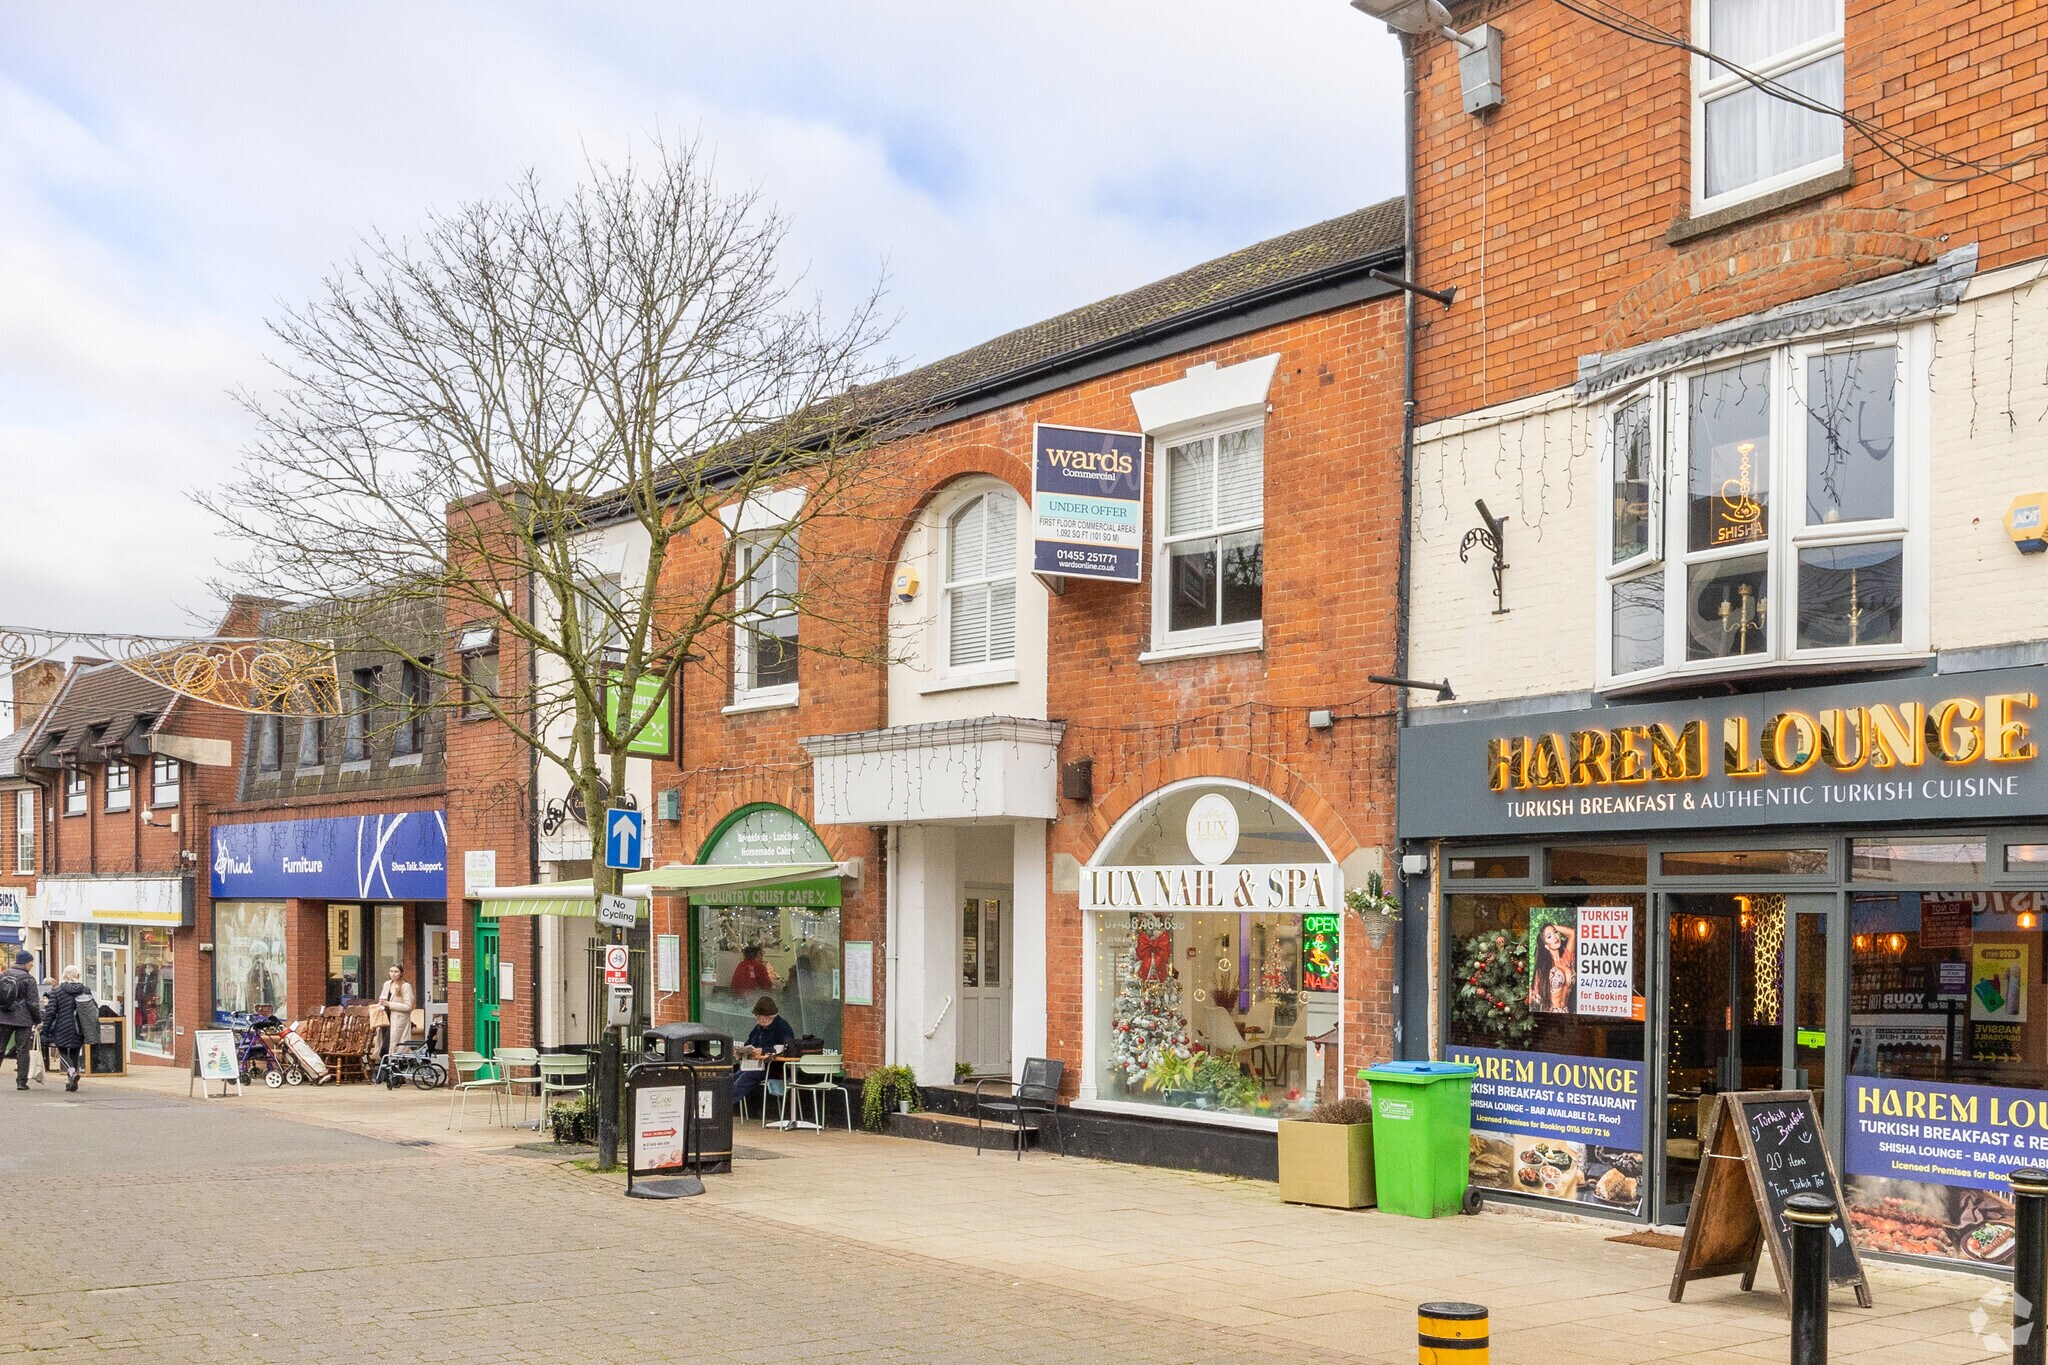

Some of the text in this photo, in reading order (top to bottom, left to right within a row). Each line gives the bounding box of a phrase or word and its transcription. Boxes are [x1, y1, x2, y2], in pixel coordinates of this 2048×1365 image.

[1046, 448, 1132, 474] wards
[1062, 468, 1116, 481] Commercial
[1049, 501, 1127, 518] UNDER OFFER
[1039, 518, 1136, 534] FIRST FLOOR COMMERCIAL AREAS
[1718, 522, 1763, 541] SHISHA
[1072, 530, 1081, 538] SQ
[1082, 531, 1089, 539] FT
[1103, 534, 1111, 542] SQ
[1056, 550, 1117, 564] 01455 251771
[1059, 560, 1115, 572] wardsonline.co.uk
[1487, 692, 2039, 791] HAREM LOUNGE
[1506, 775, 2019, 818] TURKISH BREAKFAST & AUTHENTIC TURKISH CUISINE
[773, 831, 800, 841] Lunches
[1197, 820, 1228, 836] LUX
[741, 846, 796, 857] Homemade Cakes
[283, 857, 323, 873] Furniture
[1091, 867, 1328, 908] LUX NAIL & SPA
[613, 899, 626, 909] No
[705, 889, 814, 904] COUNTRY CRUST CAFE
[602, 908, 634, 923] Cycling
[1581, 910, 1629, 921] TURKISH
[1306, 917, 1340, 933] OPEN
[1581, 925, 1628, 939] BELLY
[1580, 943, 1628, 957] DANCE
[1580, 960, 1628, 975] SHOW
[1305, 973, 1340, 990] NAILS
[1580, 979, 1628, 988] 24/12/2024
[1580, 991, 1628, 1002] for Booking
[1541, 1062, 1639, 1094] LOUNGE
[1471, 1083, 1637, 1111] KISH BREAKFAST & RESTAURANT
[1858, 1086, 1978, 1124] HAREM
[1494, 1102, 1524, 1113] LOUNGE
[1530, 1106, 1545, 1116] BAR
[1547, 1108, 1587, 1121] AVAILABLE
[1599, 1114, 1621, 1125] Floor)
[1476, 1114, 1502, 1123] Licensed
[1503, 1117, 1529, 1127] Premises
[1540, 1122, 1565, 1133] Booking
[1859, 1119, 1920, 1138] TURKISH
[1923, 1126, 2010, 1147] BREAKFAST
[2013, 1134, 2025, 1148] &
[1879, 1142, 1917, 1155] SHISHA
[1918, 1146, 1963, 1160] LOUNGE
[1973, 1151, 1996, 1164] BAR
[1766, 1152, 1782, 1171] 20
[1891, 1160, 1930, 1173] Licensed
[1931, 1164, 1972, 1178] Premises
[1973, 1169, 1986, 1179] for
